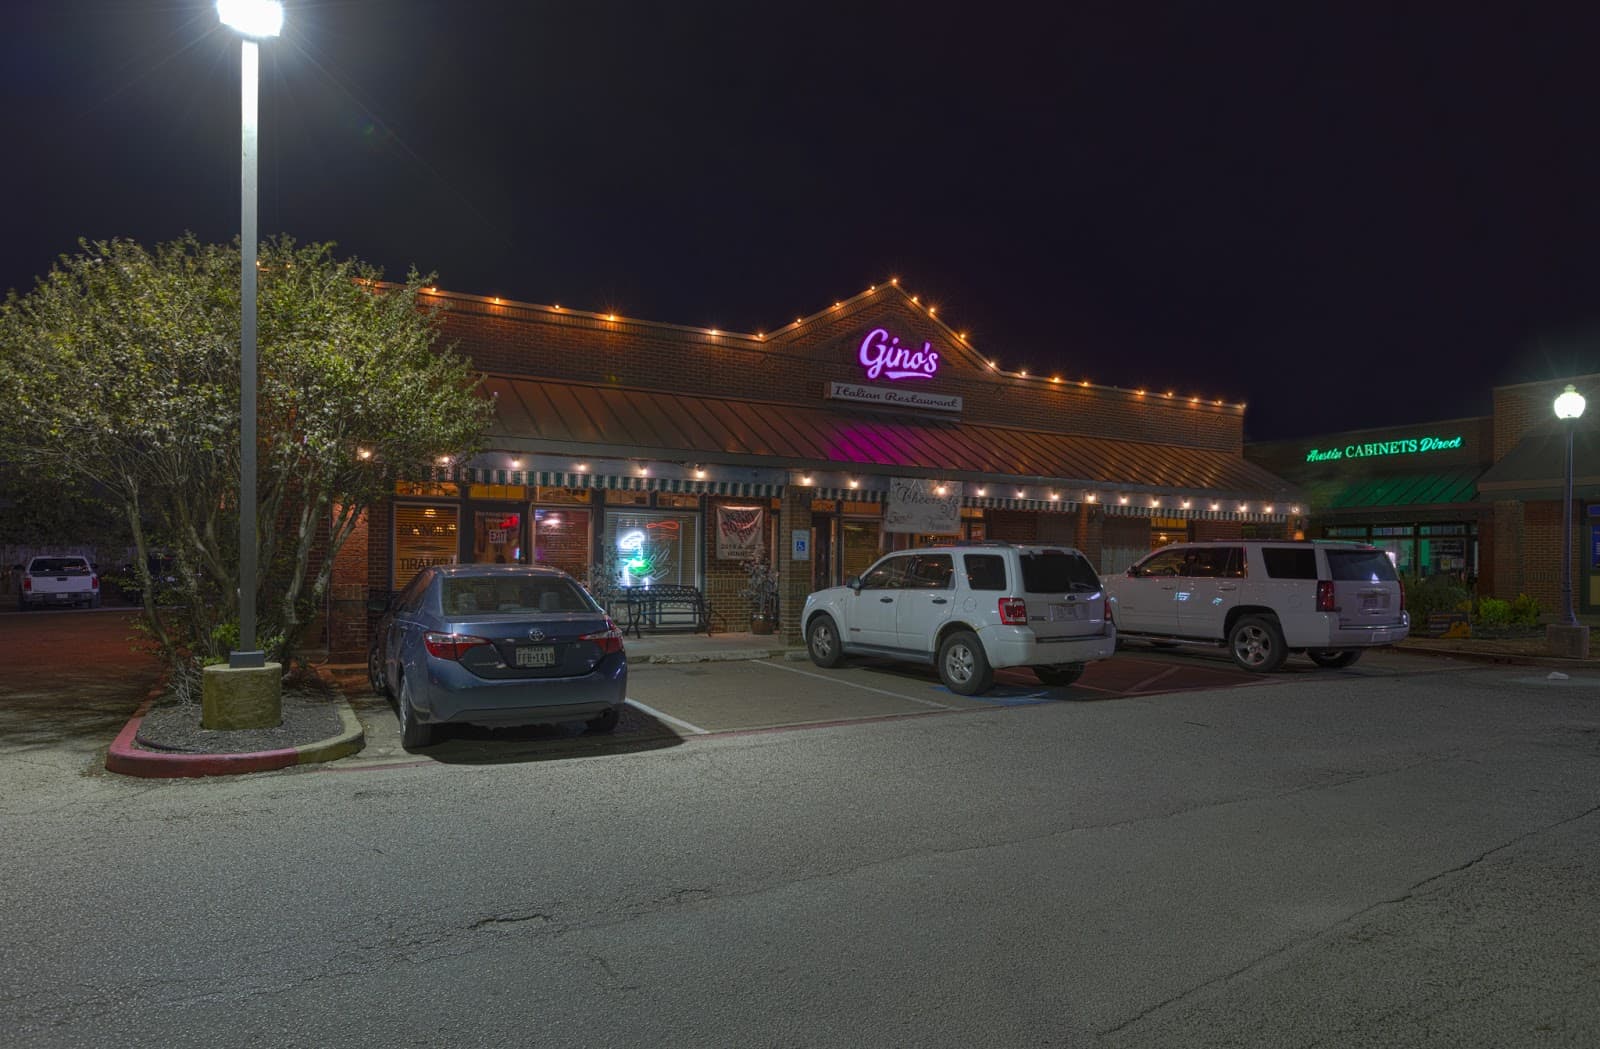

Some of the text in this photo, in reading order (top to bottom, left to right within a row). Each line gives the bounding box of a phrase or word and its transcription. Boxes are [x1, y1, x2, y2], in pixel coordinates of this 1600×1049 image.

[859, 328, 939, 379] Gino's
[834, 385, 958, 408] Italian Restaurant
[1306, 436, 1463, 462] Austin CABINETS Direct
[490, 530, 507, 542] EXIT
